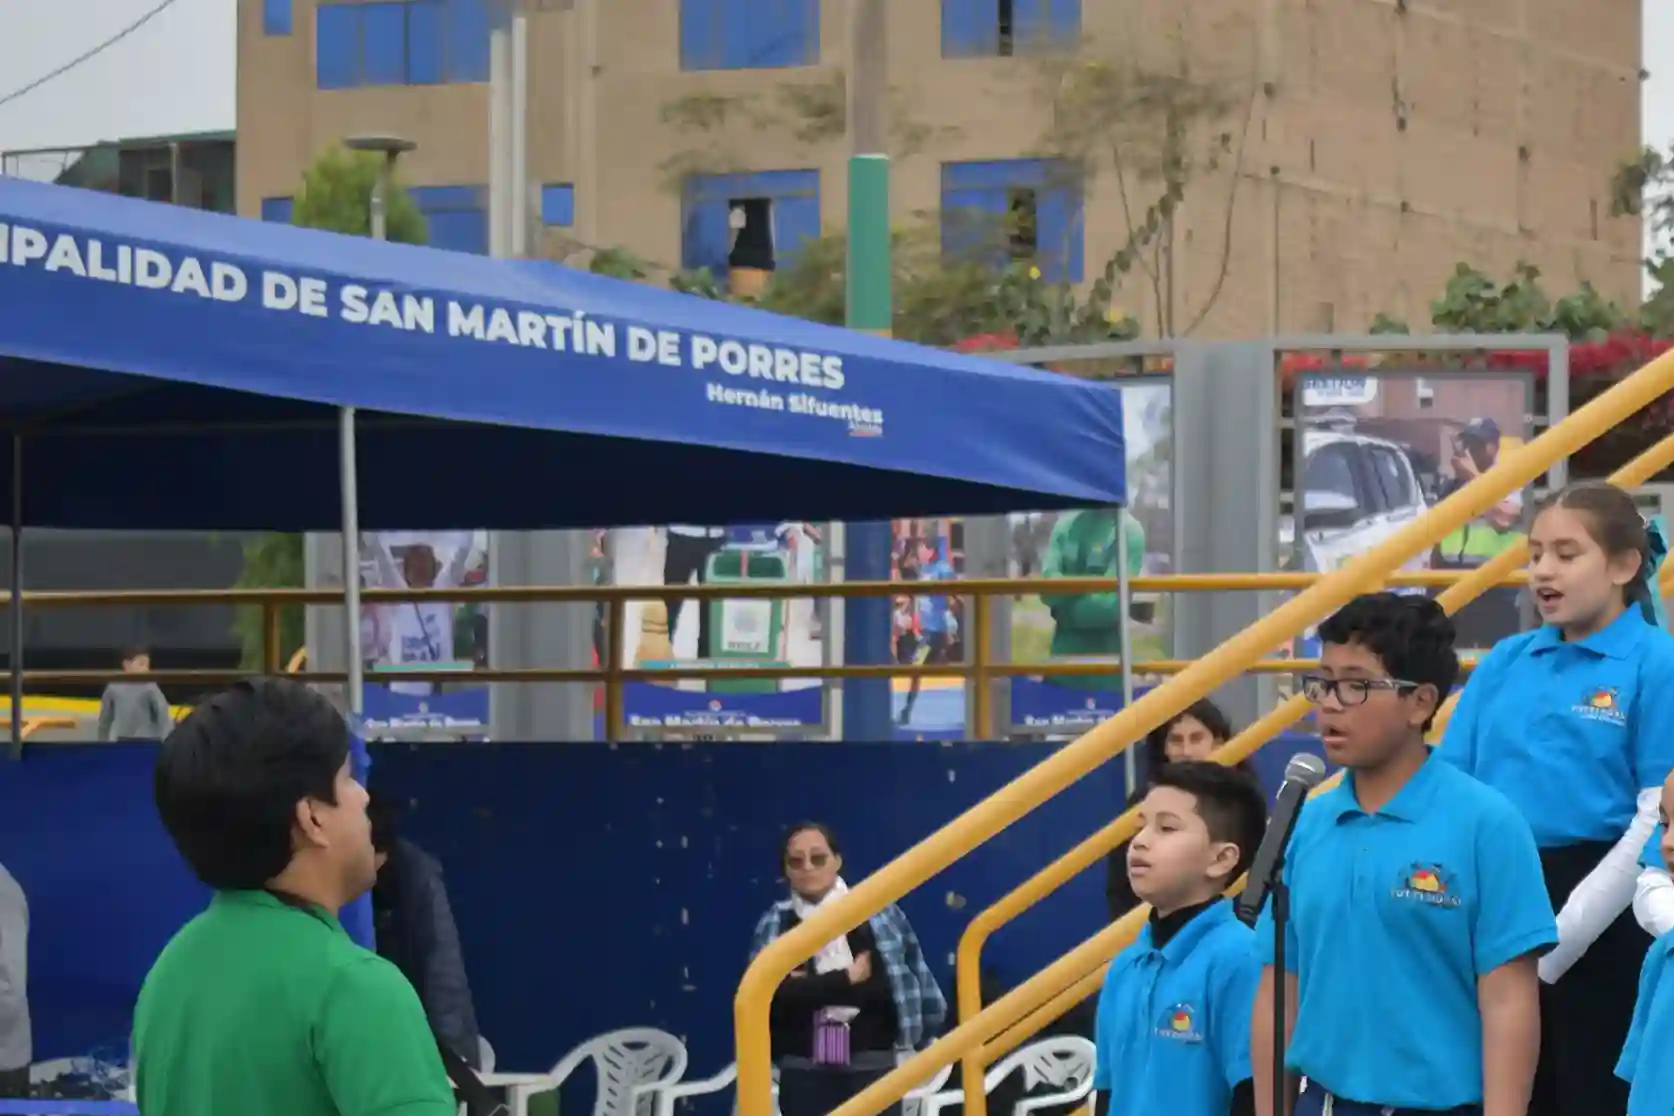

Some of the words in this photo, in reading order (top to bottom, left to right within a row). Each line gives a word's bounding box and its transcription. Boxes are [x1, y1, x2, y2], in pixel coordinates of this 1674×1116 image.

[262, 271, 328, 317] DE
[340, 284, 434, 333] SAN
[448, 301, 615, 357] MARTÍN
[627, 326, 681, 366] DE
[692, 335, 844, 390] PORRES
[706, 383, 783, 411] Hernán
[788, 391, 883, 424] Sifuentes
